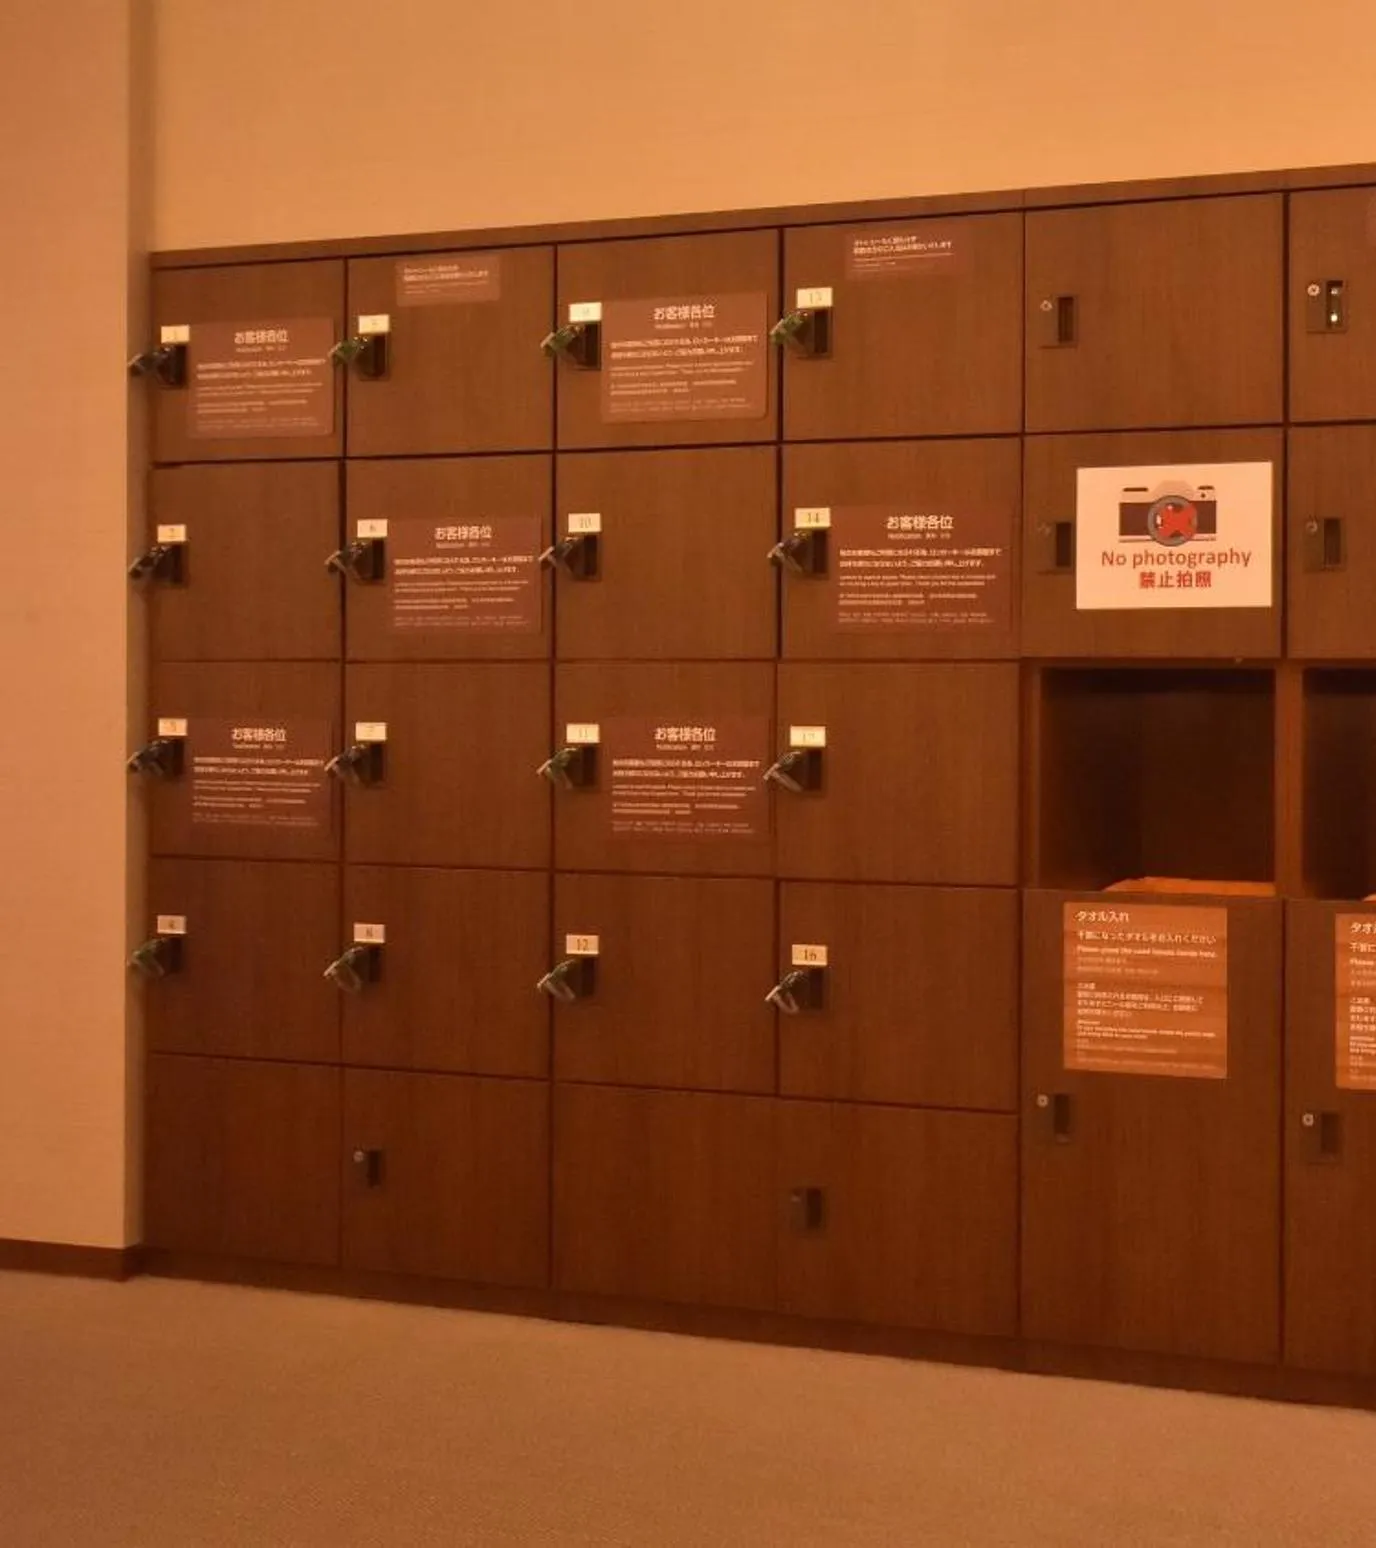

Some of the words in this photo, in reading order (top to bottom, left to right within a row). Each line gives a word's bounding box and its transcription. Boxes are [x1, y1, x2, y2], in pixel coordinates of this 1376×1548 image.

[653, 304, 716, 321] お客様各位
[886, 514, 954, 531] お客様各位
[1101, 550, 1127, 567] No
[1132, 547, 1253, 570] photography
[1139, 571, 1213, 590] 禁止拍照
[653, 726, 717, 743] お客様各位
[1076, 909, 1131, 924] タオル入れ
